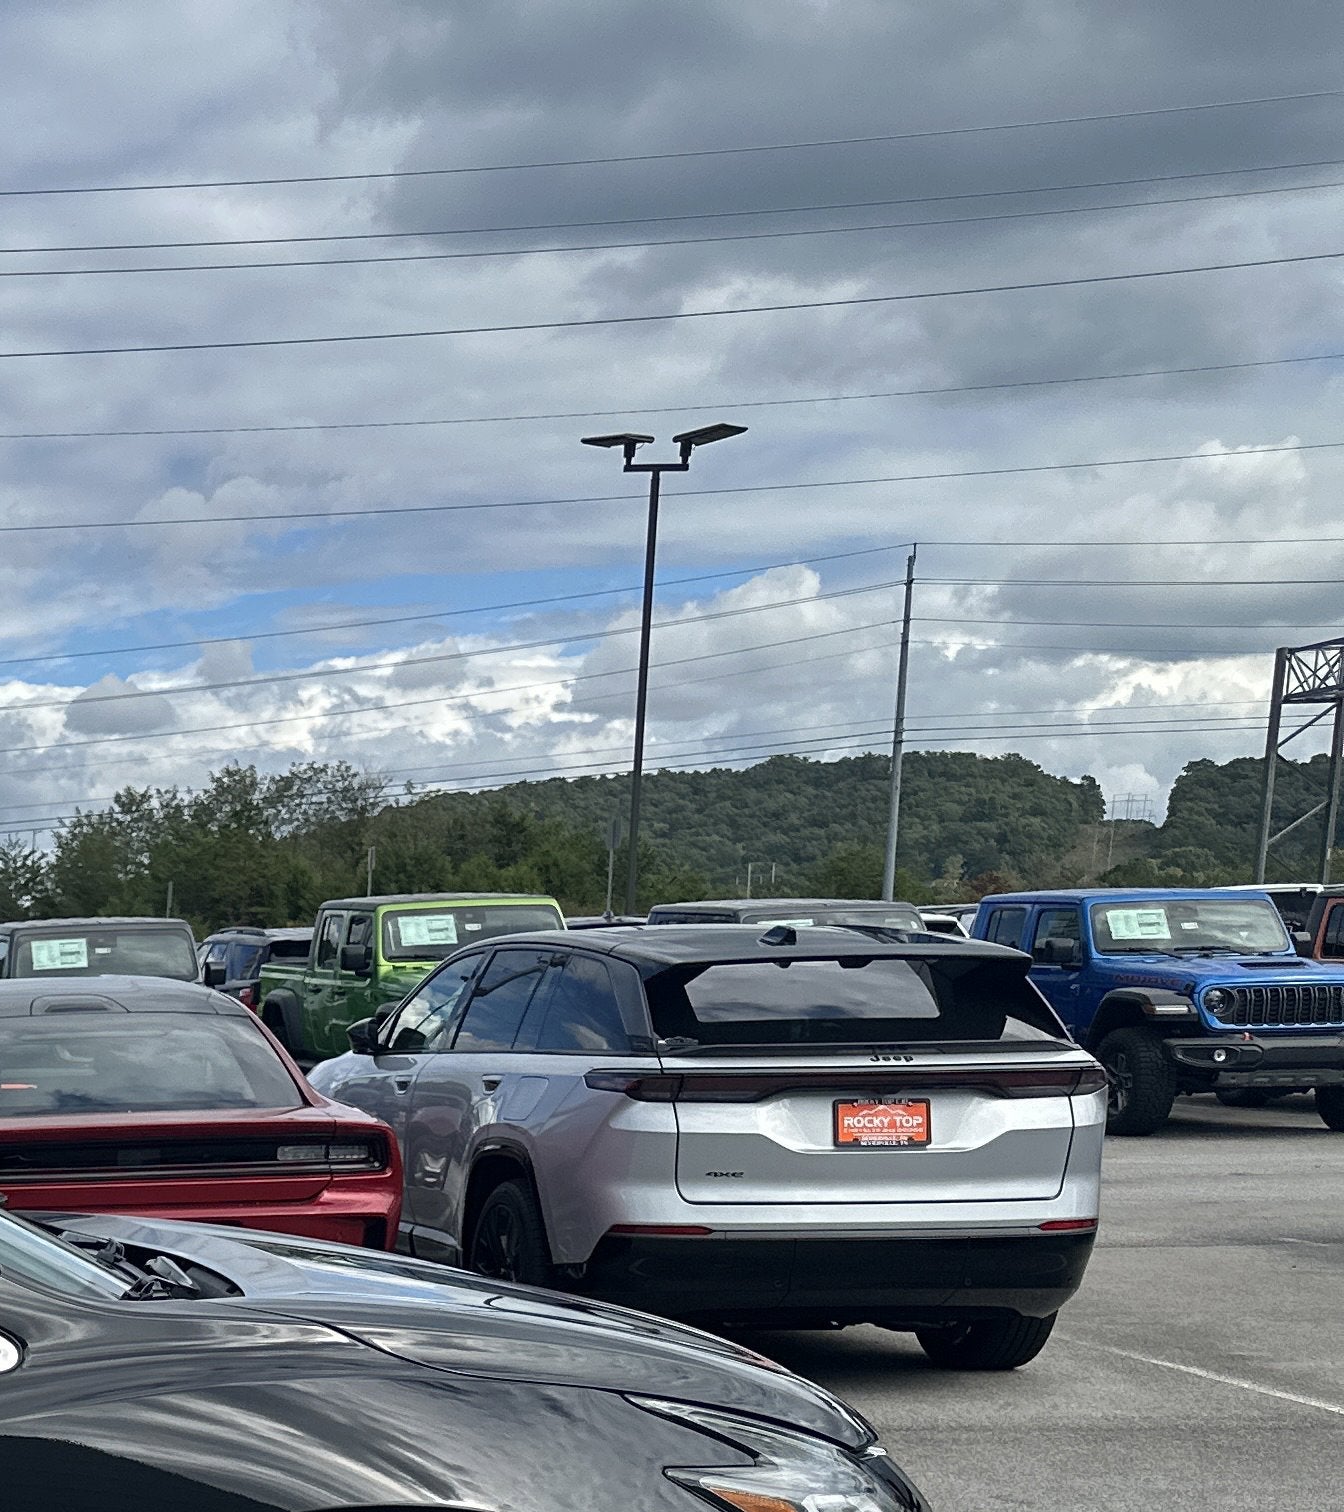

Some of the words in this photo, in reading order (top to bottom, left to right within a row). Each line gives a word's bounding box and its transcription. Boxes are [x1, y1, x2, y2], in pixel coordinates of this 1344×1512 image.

[869, 1054, 914, 1063] Jeep
[843, 1116, 891, 1128] ROCKY
[892, 1116, 923, 1128] TOP
